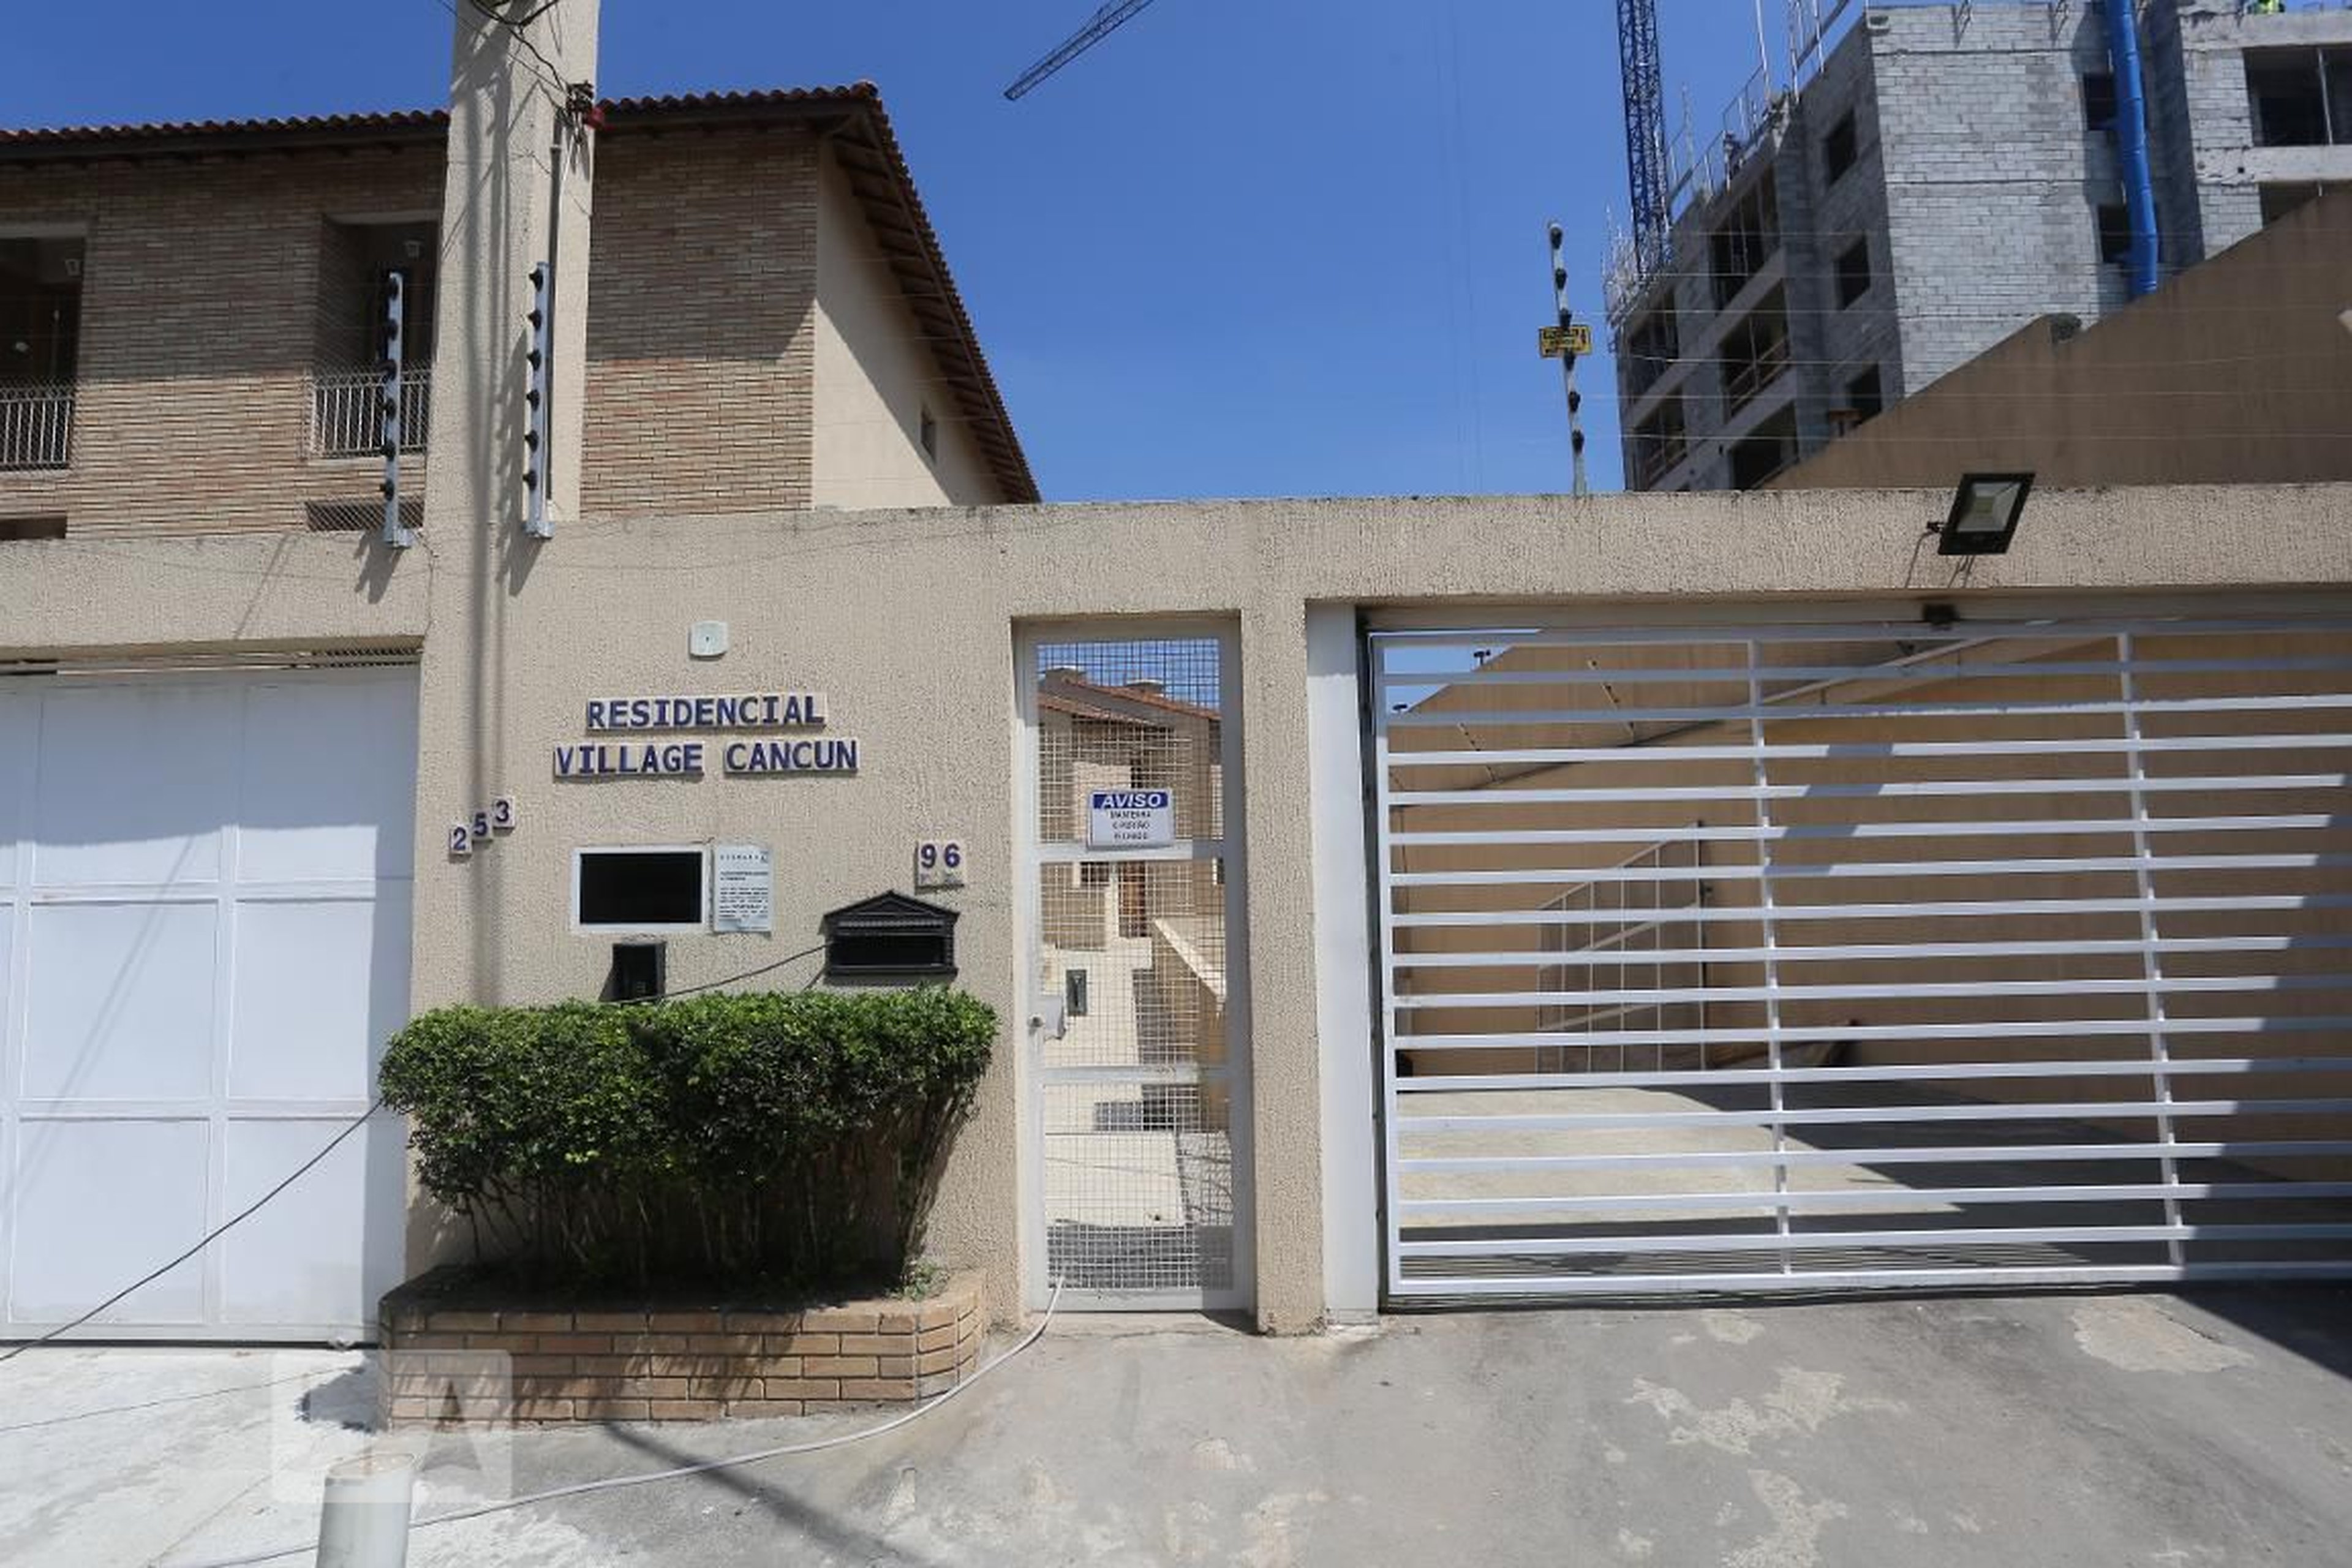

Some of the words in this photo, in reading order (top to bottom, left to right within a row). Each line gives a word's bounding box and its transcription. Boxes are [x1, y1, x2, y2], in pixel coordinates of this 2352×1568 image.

[587, 696, 825, 728] RESIDENCIAL
[556, 744, 704, 774] VILLAGE
[725, 740, 857, 771] CANCUN
[1102, 793, 1161, 809] AVISO
[453, 799, 509, 851] 253
[921, 843, 960, 869] 96
